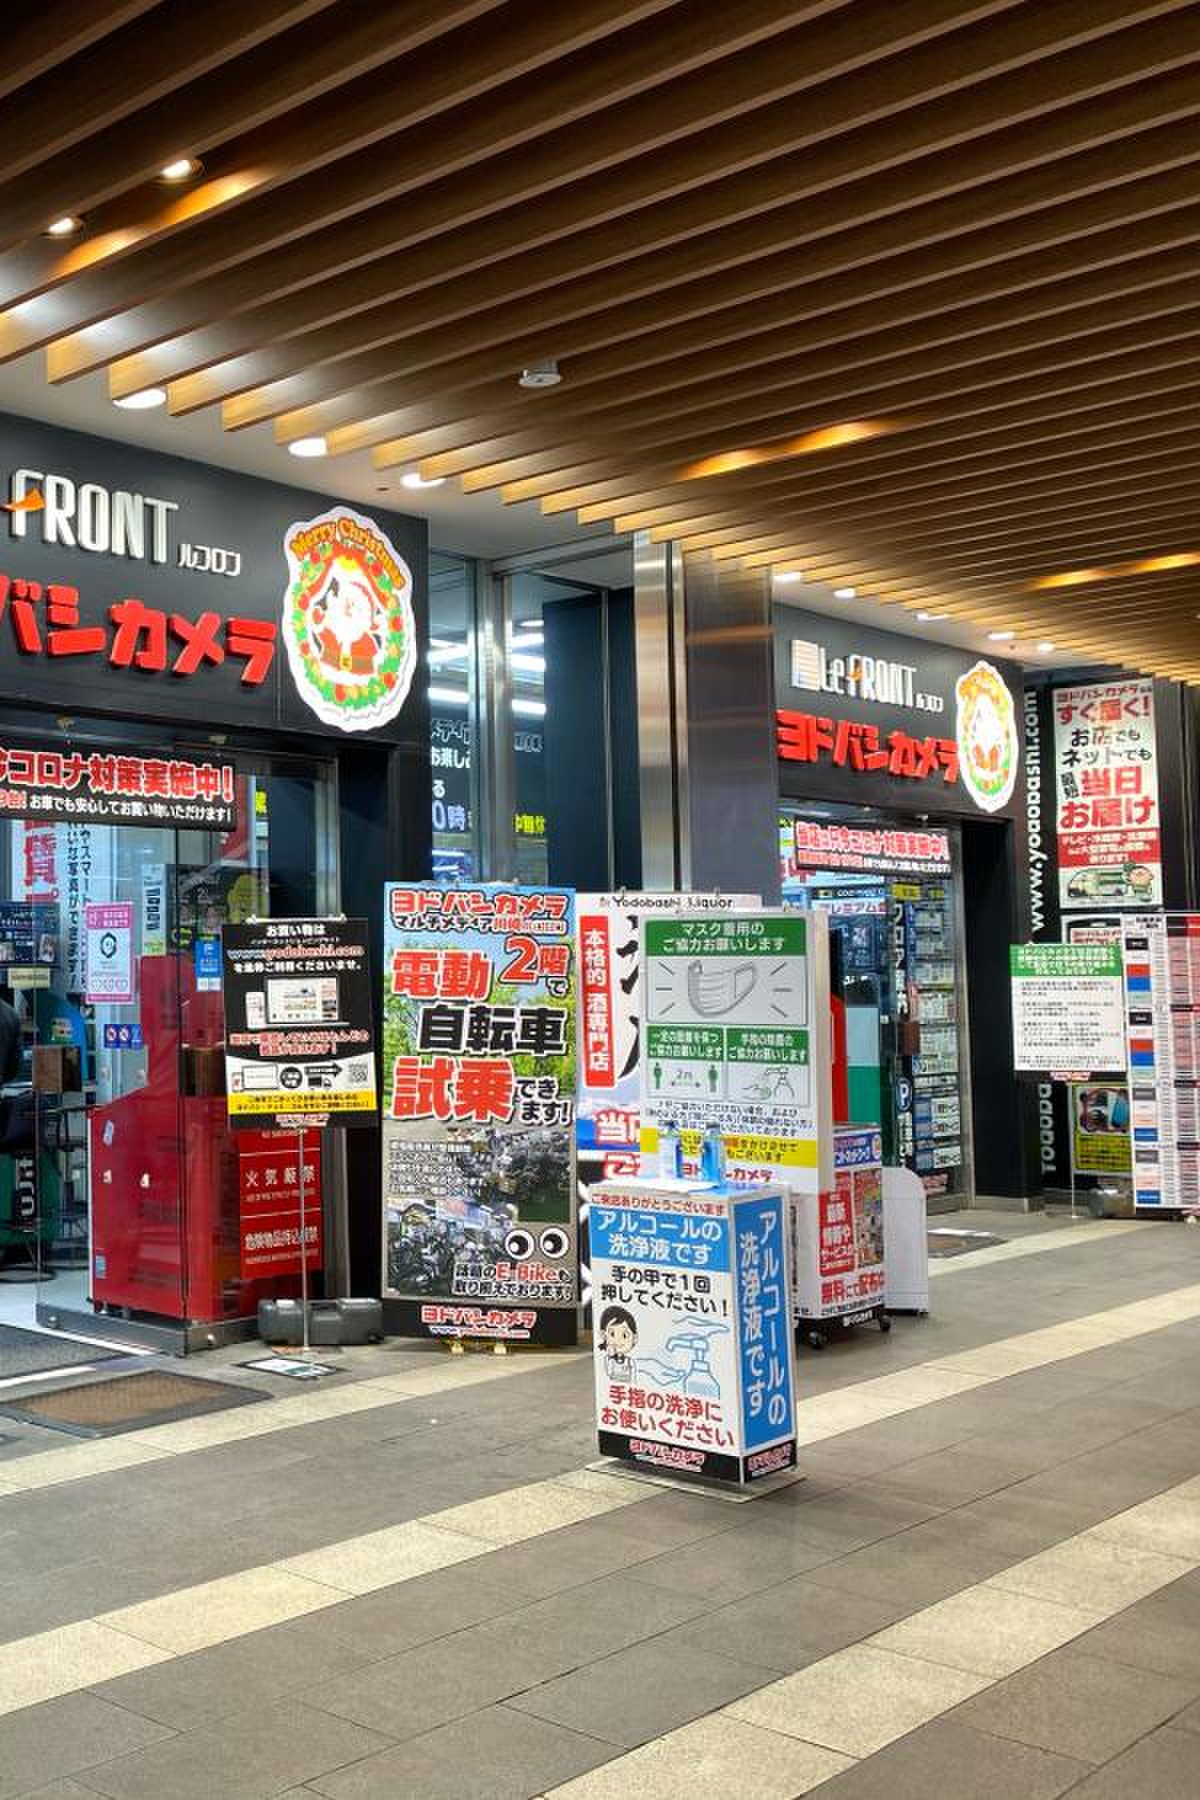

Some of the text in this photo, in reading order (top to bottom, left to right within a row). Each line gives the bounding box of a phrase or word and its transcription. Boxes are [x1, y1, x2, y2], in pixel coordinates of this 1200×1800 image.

[1, 468, 179, 563] FRONT
[290, 516, 406, 590] Merry Christmas
[775, 709, 960, 785] ヨドバシカメラ
[1081, 766, 1142, 798] 当日
[1060, 795, 1156, 829] お届け
[392, 889, 568, 919] ヨドバシカメラ
[393, 949, 492, 1000] 電動
[584, 929, 608, 986] 本格的
[418, 1003, 568, 1054] 自転車
[392, 1056, 513, 1121] 試乗
[596, 1210, 722, 1242] アルコールの
[608, 1232, 713, 1265] 洗浄液です
[611, 1265, 711, 1294] 手の甲で1回
[421, 1304, 537, 1328] ヨドバシカメラ
[601, 1284, 729, 1317] 押してください!
[758, 1210, 786, 1426] アルコールの
[739, 1231, 763, 1419] 洗浄液です
[608, 1384, 724, 1423] 手指の洗浄に
[601, 1406, 735, 1447] お使いください
